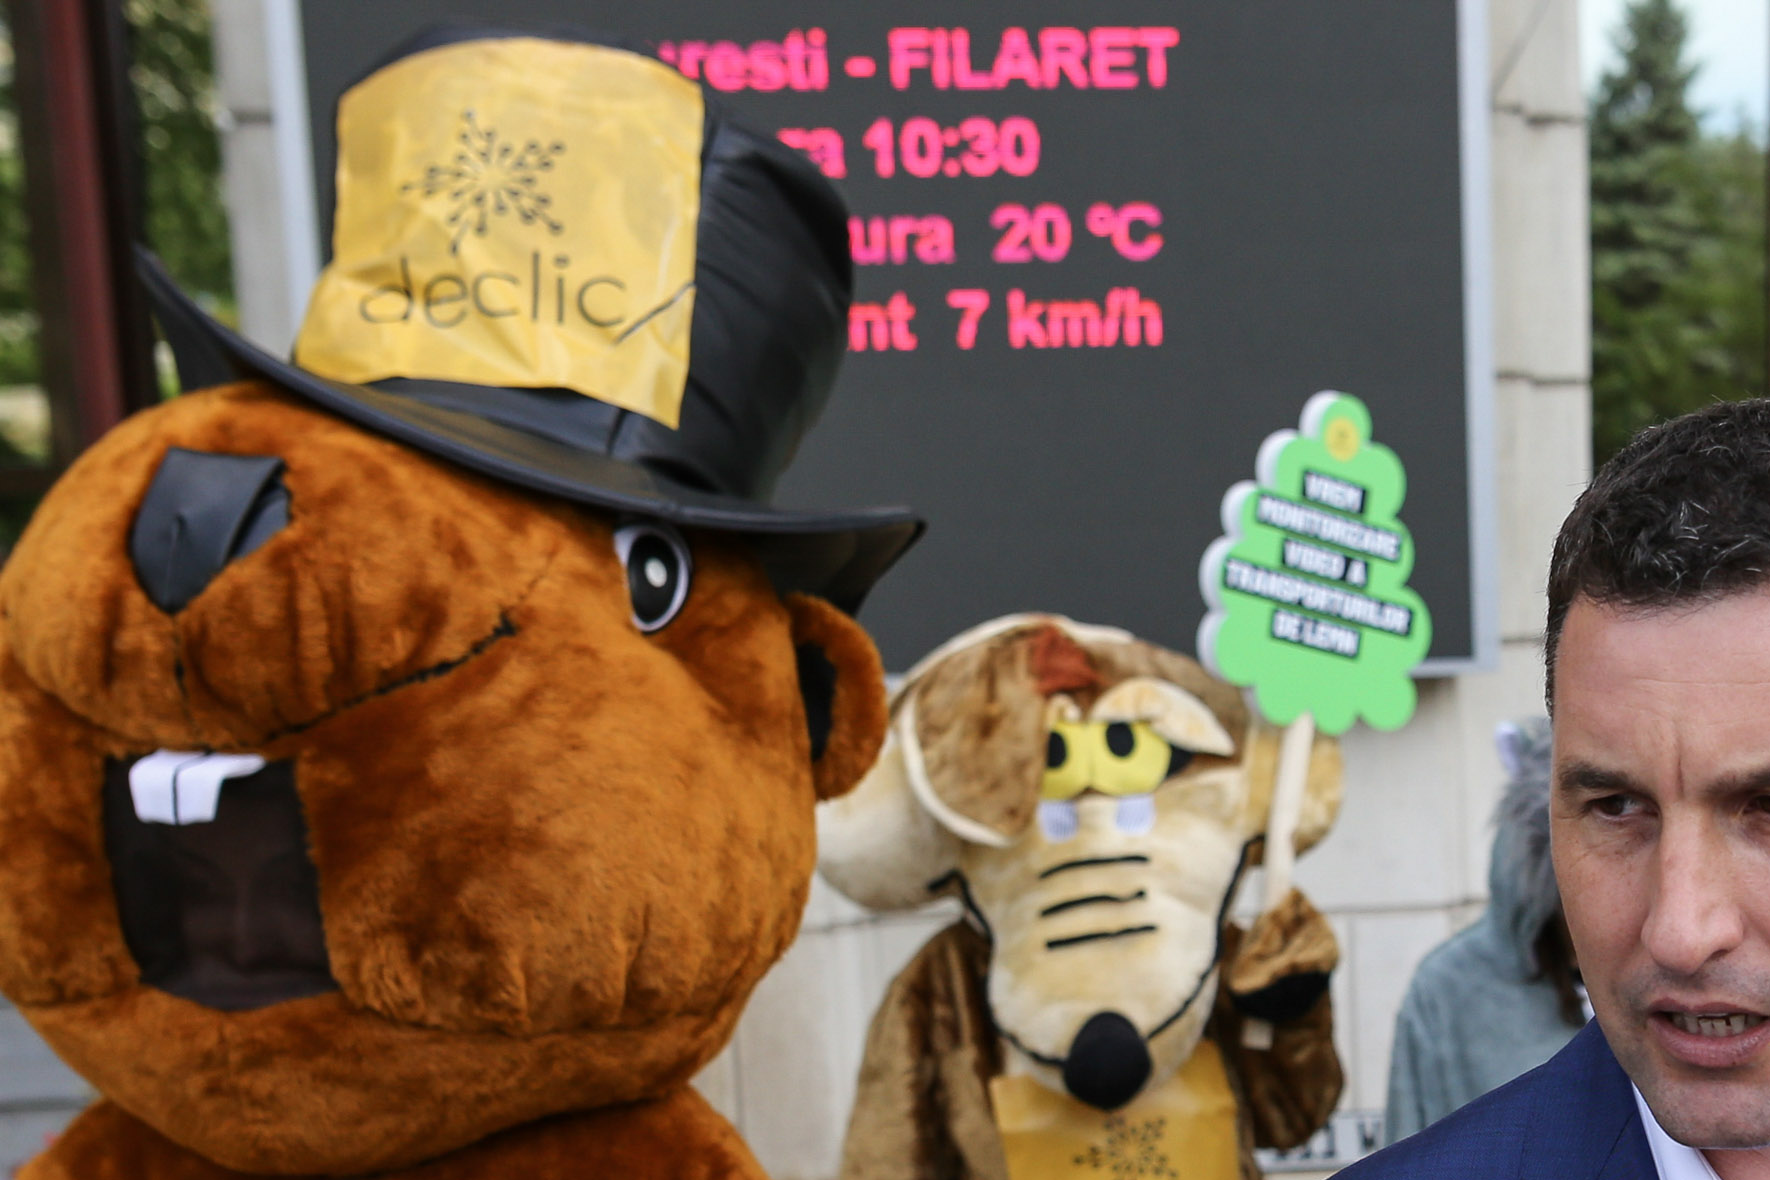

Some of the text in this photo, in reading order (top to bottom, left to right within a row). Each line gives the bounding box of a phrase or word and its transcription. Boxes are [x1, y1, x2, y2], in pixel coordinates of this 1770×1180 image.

[658, 27, 829, 92] resti
[887, 26, 1180, 90] FILARET
[862, 116, 1041, 178] 10:30
[847, 214, 955, 265] ura
[989, 203, 1073, 263] 20
[358, 251, 628, 331] declic
[847, 286, 1164, 352] nt 7 km/h
